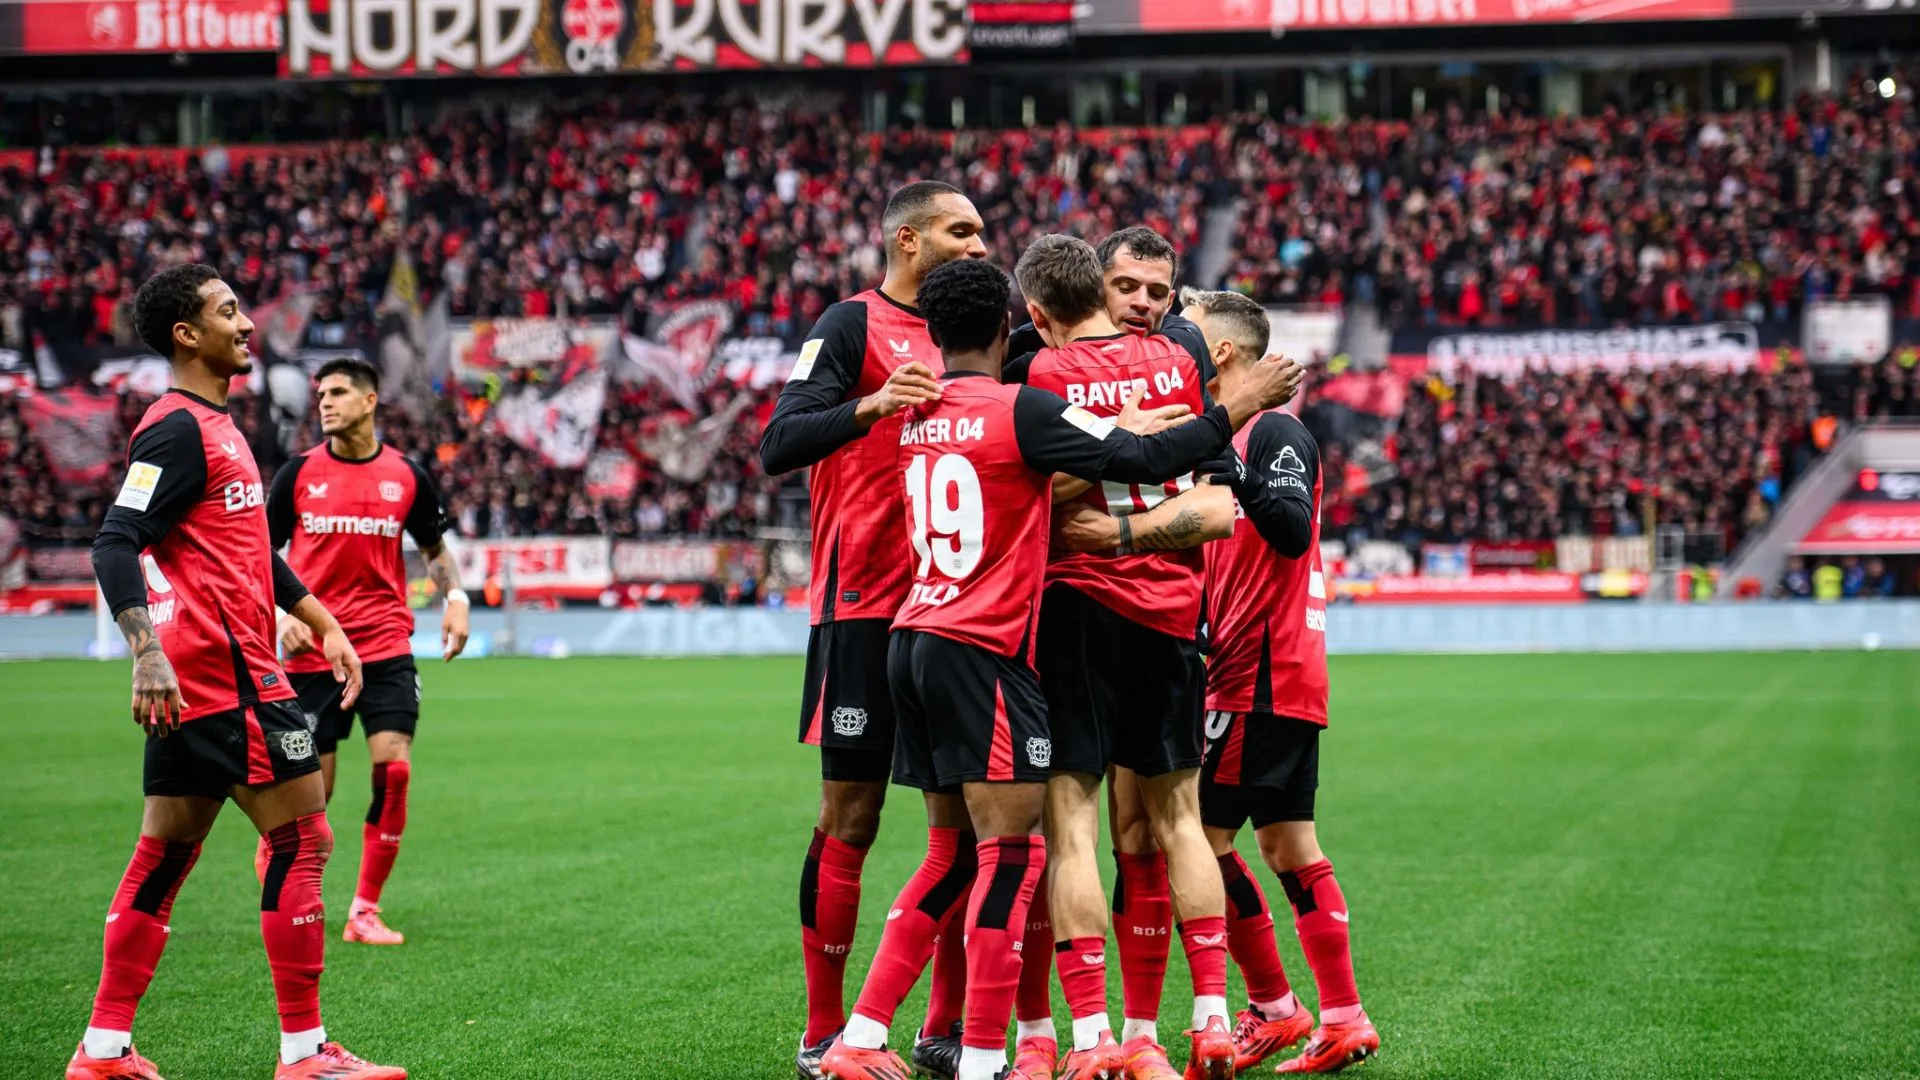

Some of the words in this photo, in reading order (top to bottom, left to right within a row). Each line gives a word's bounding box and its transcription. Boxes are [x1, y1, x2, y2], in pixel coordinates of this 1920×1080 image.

[1066, 378, 1152, 408] BAYER
[1154, 366, 1184, 396] 04
[900, 418, 951, 446] BAYER
[956, 417, 985, 442] 04
[904, 453, 984, 579] 19
